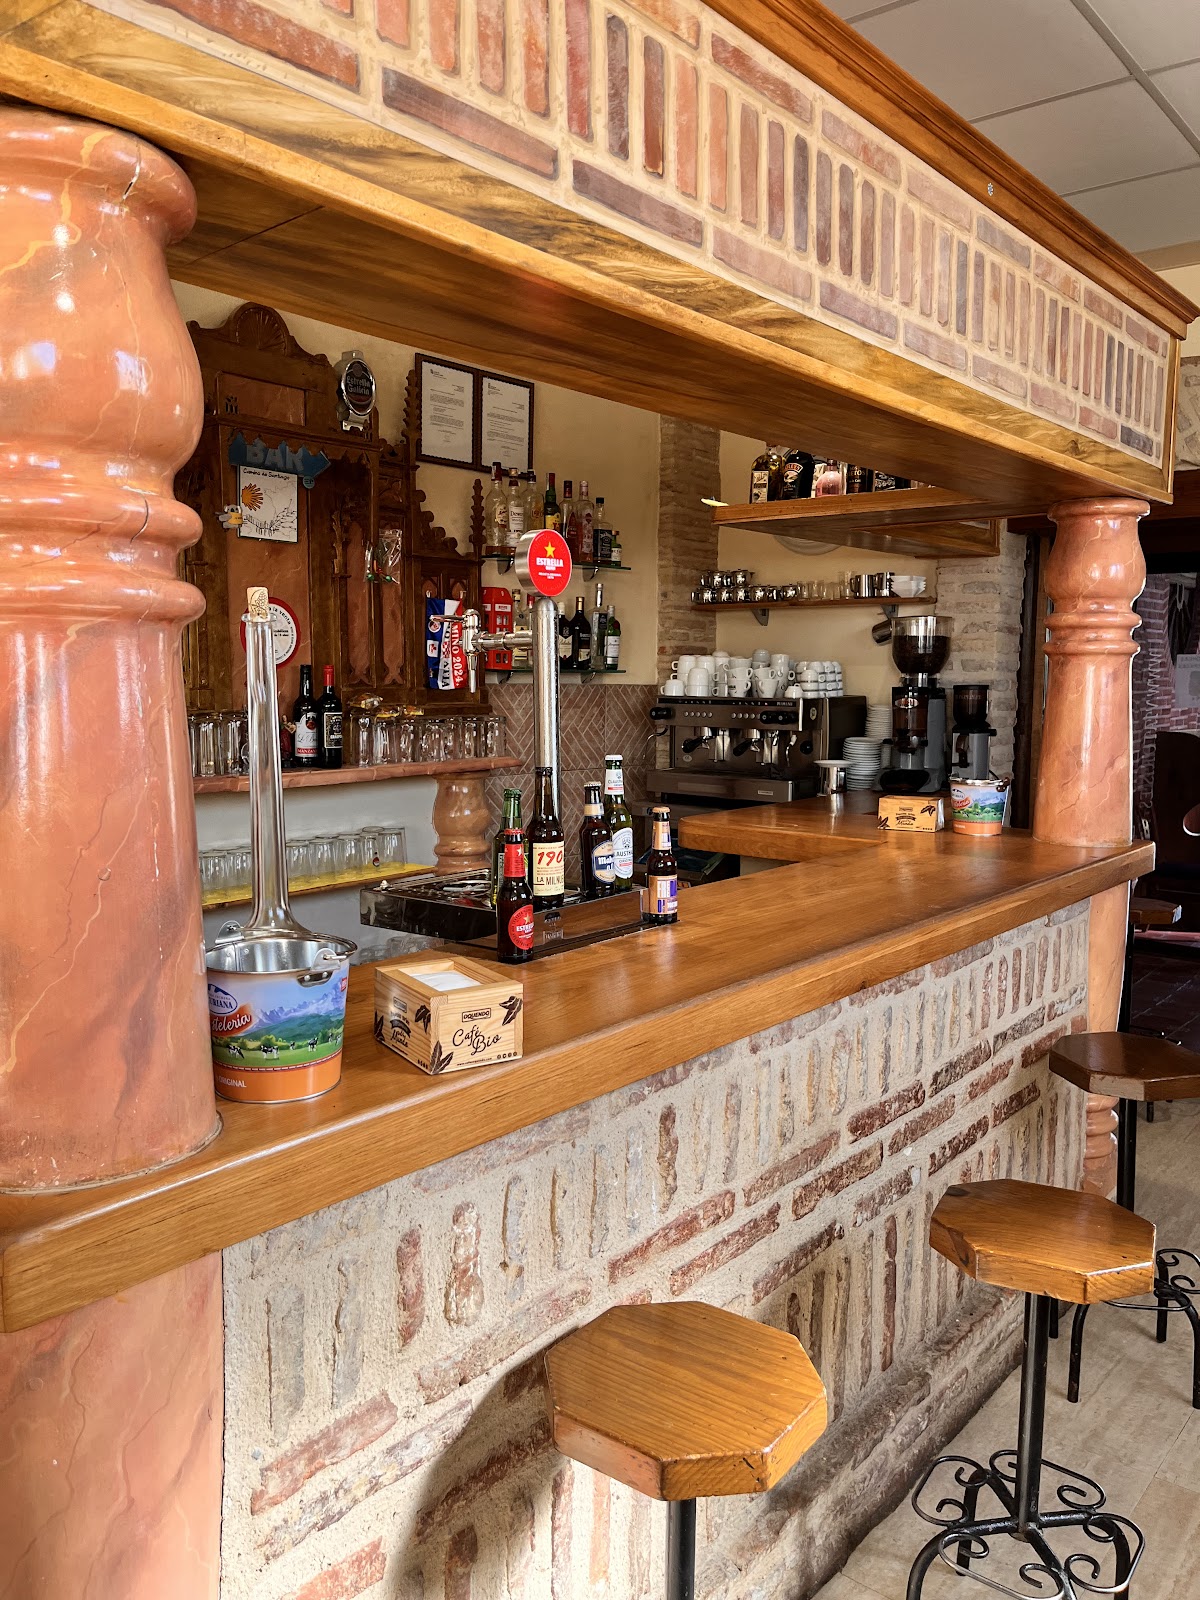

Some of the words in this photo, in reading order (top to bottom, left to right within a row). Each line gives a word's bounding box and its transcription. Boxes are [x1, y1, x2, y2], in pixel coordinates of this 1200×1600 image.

[536, 557, 564, 567] ESTRELLA
[463, 1009, 490, 1020] OQUENDO
[452, 1024, 481, 1047] Café
[471, 1033, 502, 1056] Bio
[219, 1078, 247, 1088] ORIGINAL
